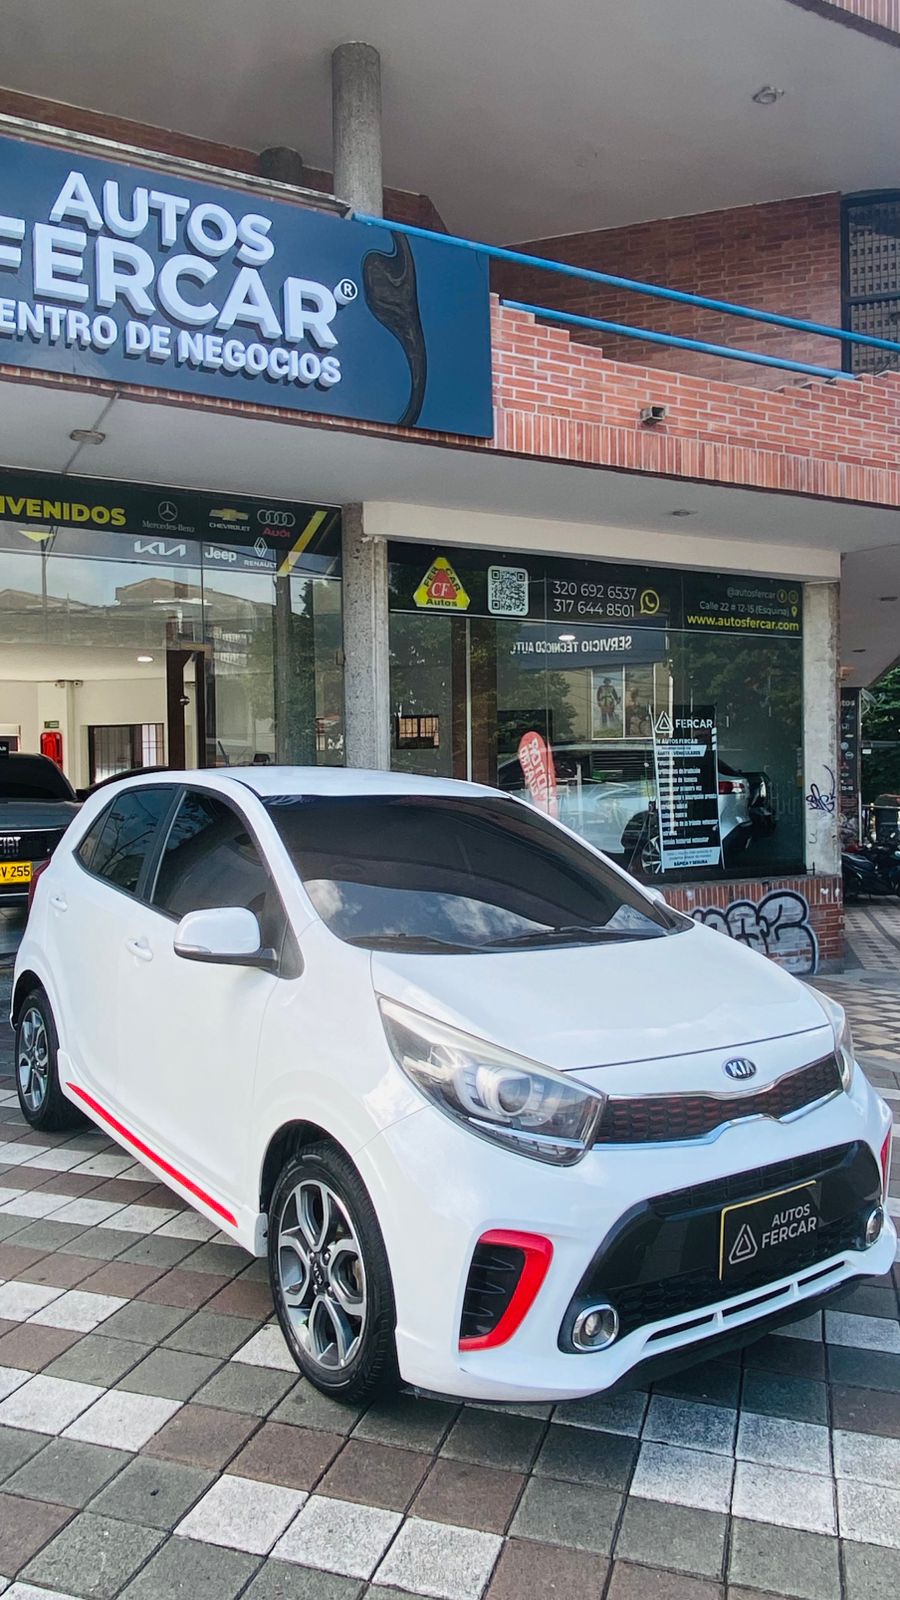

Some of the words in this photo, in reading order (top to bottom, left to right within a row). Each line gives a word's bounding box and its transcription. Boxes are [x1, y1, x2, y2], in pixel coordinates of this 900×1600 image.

[49, 170, 275, 266] AUTOS
[126, 319, 171, 360] DE
[178, 329, 342, 388] NEGOCIOS
[142, 520, 195, 534] Mercedes-Benz
[208, 522, 251, 532] CHEVROLET
[205, 547, 237, 562] Jeep
[243, 560, 278, 568] RENAULT
[431, 582, 450, 597] CF
[553, 580, 577, 596] 320
[580, 583, 604, 598] 692
[607, 585, 637, 600] 6537
[426, 598, 457, 607] Autos
[553, 598, 574, 613] 317
[577, 600, 603, 615] 644
[606, 603, 635, 618] 8501
[700, 601, 719, 611] Calle
[720, 602, 729, 612] 22
[687, 614, 800, 631] www.autosfercar.com
[675, 718, 713, 729] FERCAR
[10, 865, 30, 878] 255
[727, 1059, 755, 1077] KIA
[771, 1203, 811, 1228] AUTOS
[761, 1217, 817, 1249] FERCAR
